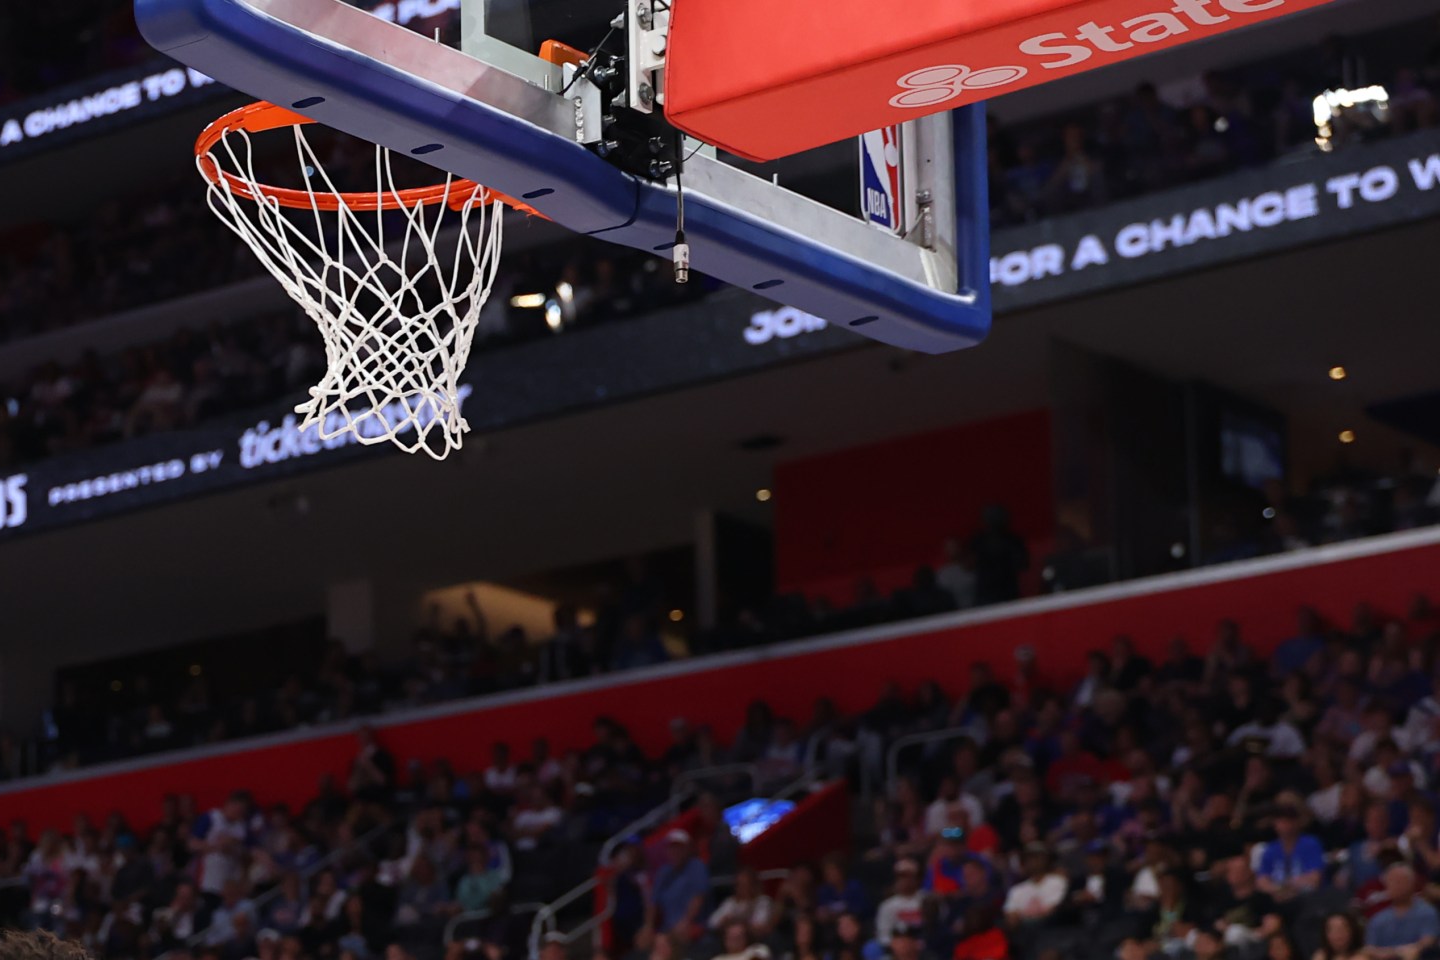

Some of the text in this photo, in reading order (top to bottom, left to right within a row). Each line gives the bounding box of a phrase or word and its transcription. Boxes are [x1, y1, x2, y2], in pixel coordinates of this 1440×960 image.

[0, 118, 23, 146] A
[23, 80, 142, 137] CHANCE
[142, 68, 186, 100] TO
[866, 186, 888, 220] NBA
[1071, 234, 1109, 270] A
[1115, 183, 1320, 258] CHANCE
[1325, 165, 1400, 209] TO
[48, 459, 186, 506] PRESENTED
[190, 449, 225, 474] BY
